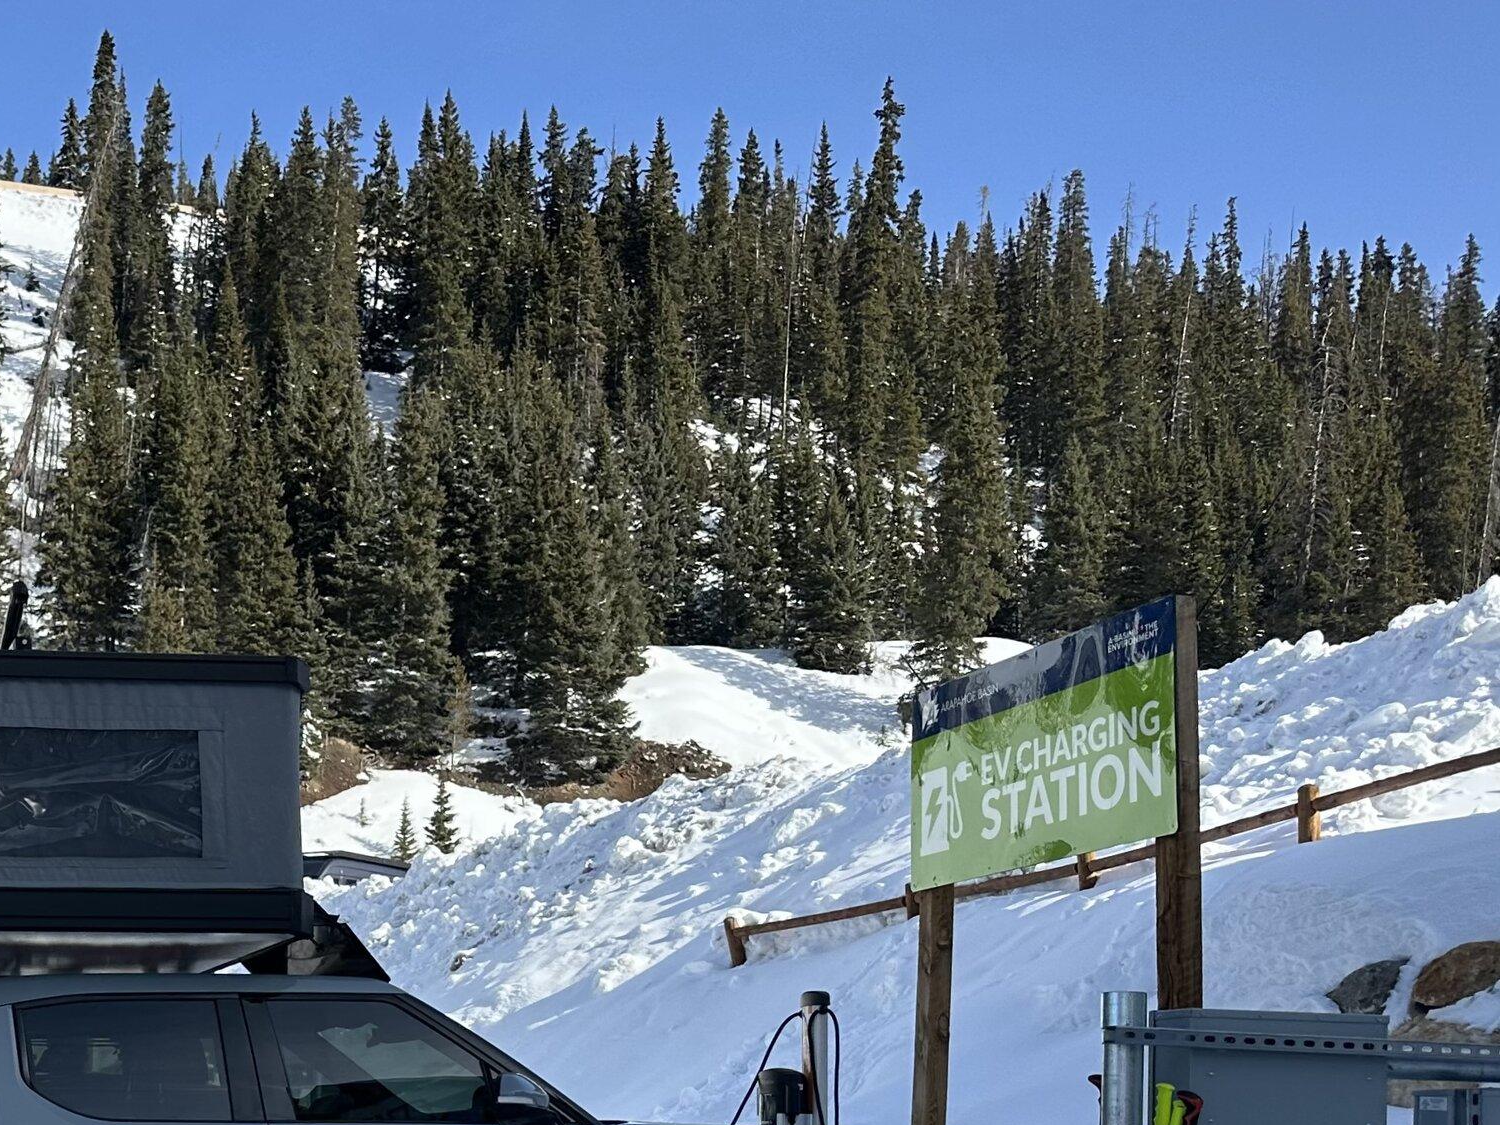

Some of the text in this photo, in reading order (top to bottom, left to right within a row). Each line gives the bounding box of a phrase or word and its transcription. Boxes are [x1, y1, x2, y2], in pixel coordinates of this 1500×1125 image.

[1107, 628, 1159, 654] ENVIRONMENT
[1145, 620, 1158, 632] THE
[980, 700, 1161, 785] EV CHARGING
[980, 740, 1162, 841] STATION
